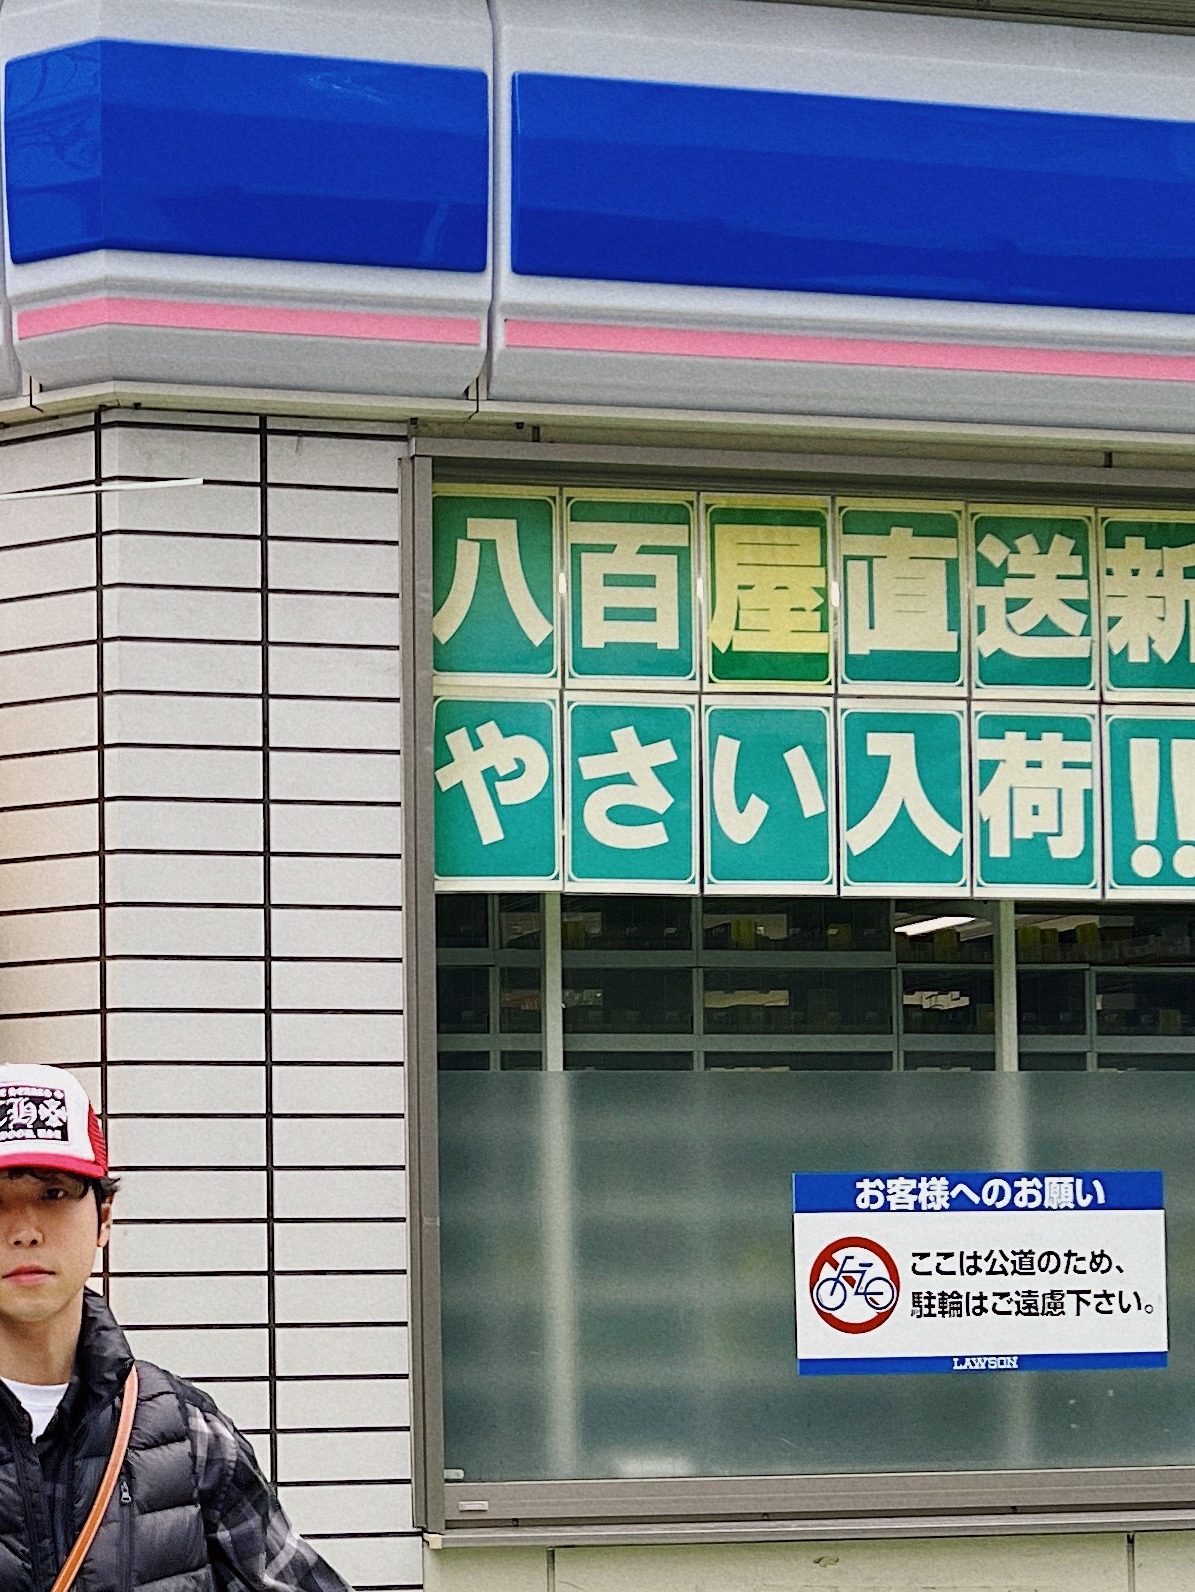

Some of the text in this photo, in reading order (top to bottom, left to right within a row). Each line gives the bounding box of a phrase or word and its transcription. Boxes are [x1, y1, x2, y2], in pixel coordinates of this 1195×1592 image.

[855, 1176, 1106, 1211] お客様へのお願い
[910, 1248, 1125, 1277] ここは公道のため、
[910, 1289, 1154, 1319] 駐輪はご遠慮下さい。
[952, 1355, 1019, 1370] LAWSON
